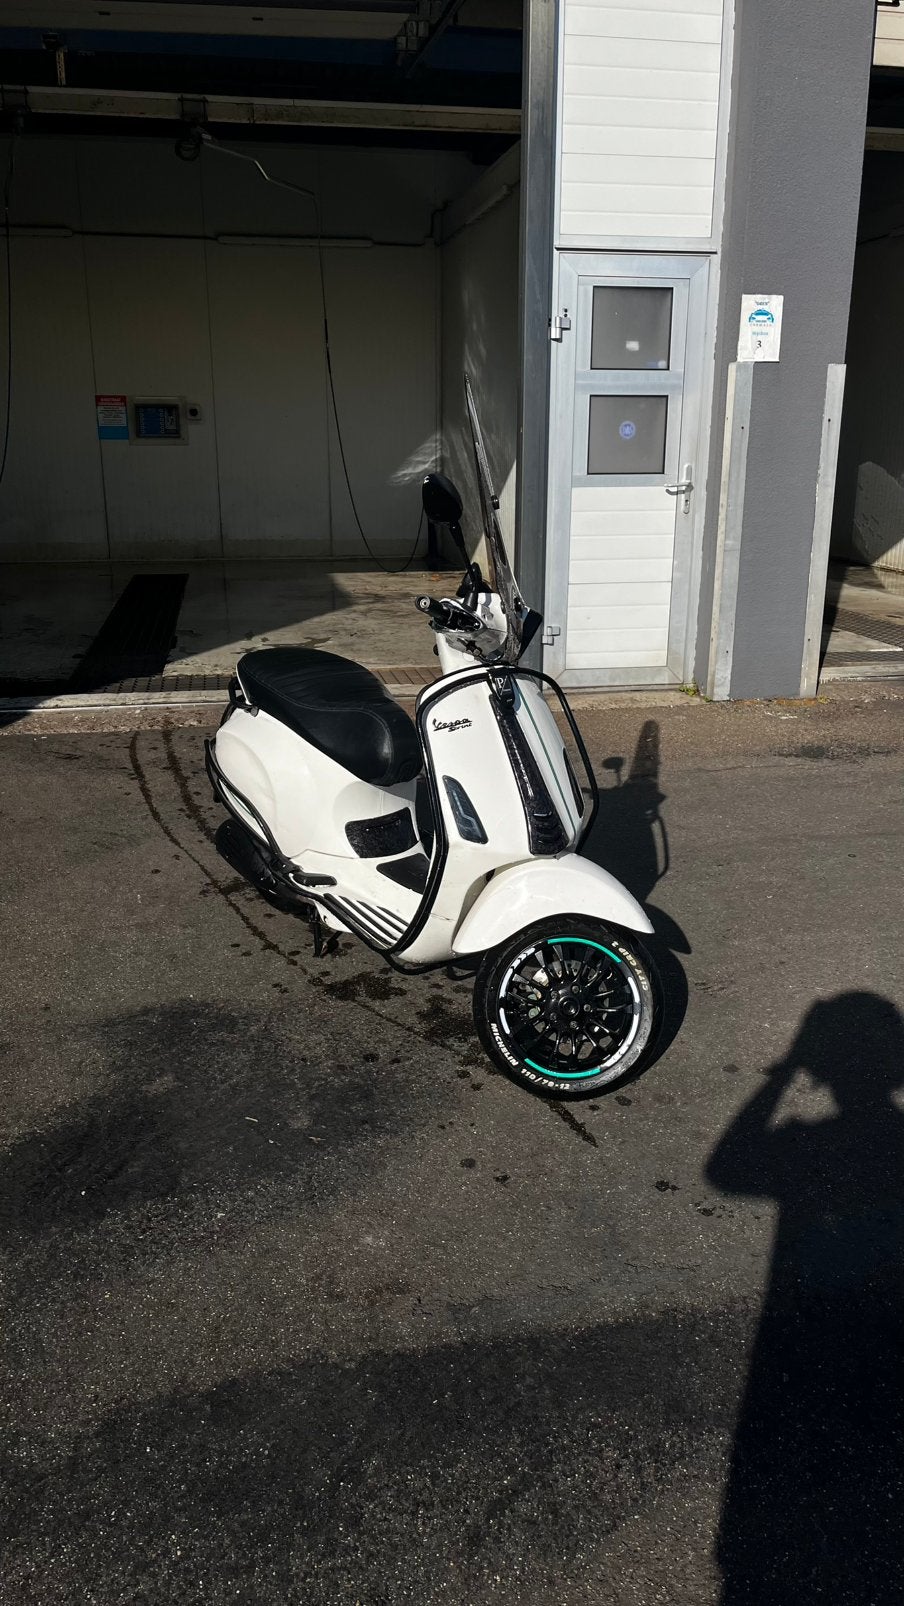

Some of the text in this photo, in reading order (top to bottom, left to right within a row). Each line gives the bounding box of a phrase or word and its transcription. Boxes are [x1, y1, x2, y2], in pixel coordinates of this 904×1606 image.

[756, 340, 762, 348] 3
[432, 718, 472, 731] Vespa
[634, 968, 649, 991] CITY
[490, 1022, 570, 1090] MICHELIN 110/70-12
